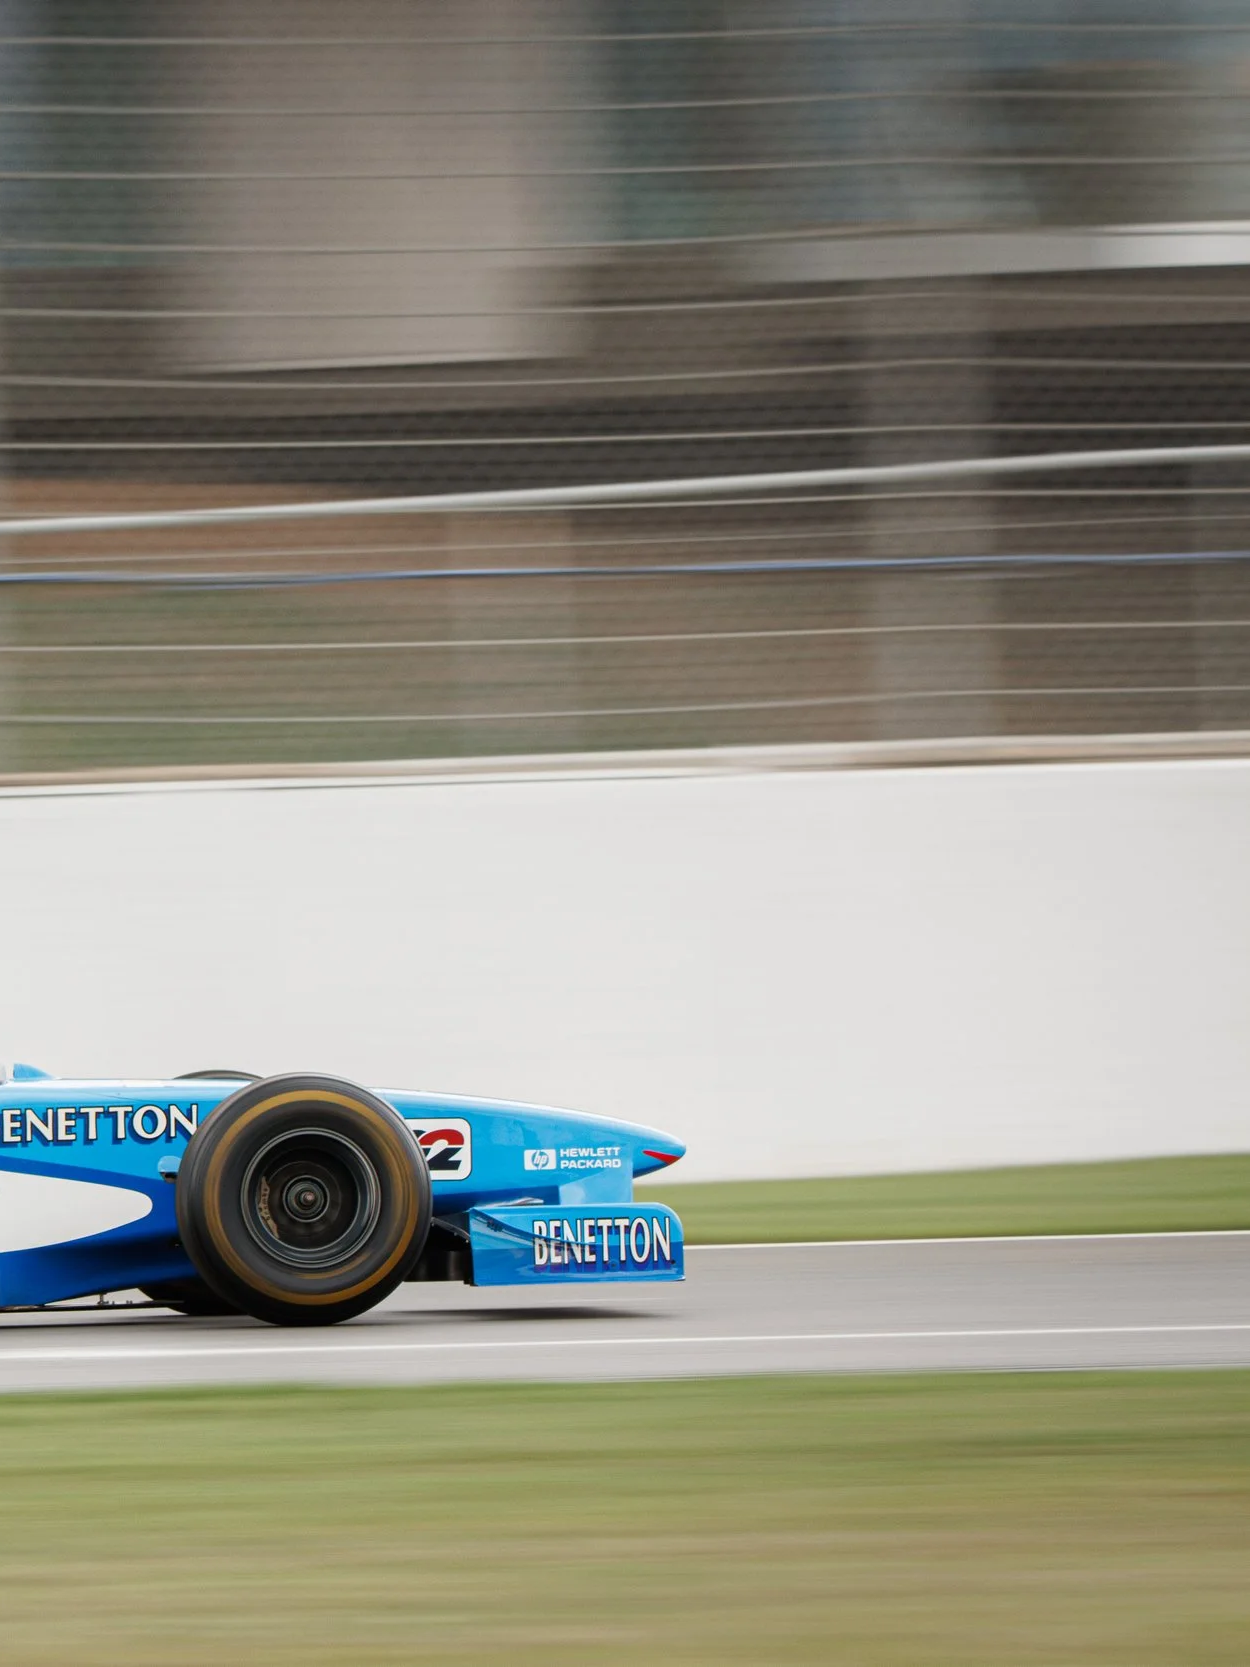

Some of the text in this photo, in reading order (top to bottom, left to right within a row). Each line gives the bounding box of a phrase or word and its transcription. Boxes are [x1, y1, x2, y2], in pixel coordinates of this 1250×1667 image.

[560, 1147, 621, 1157] HEWLETT
[560, 1159, 622, 1169] PACKARD
[533, 1216, 672, 1266] BENETTON
